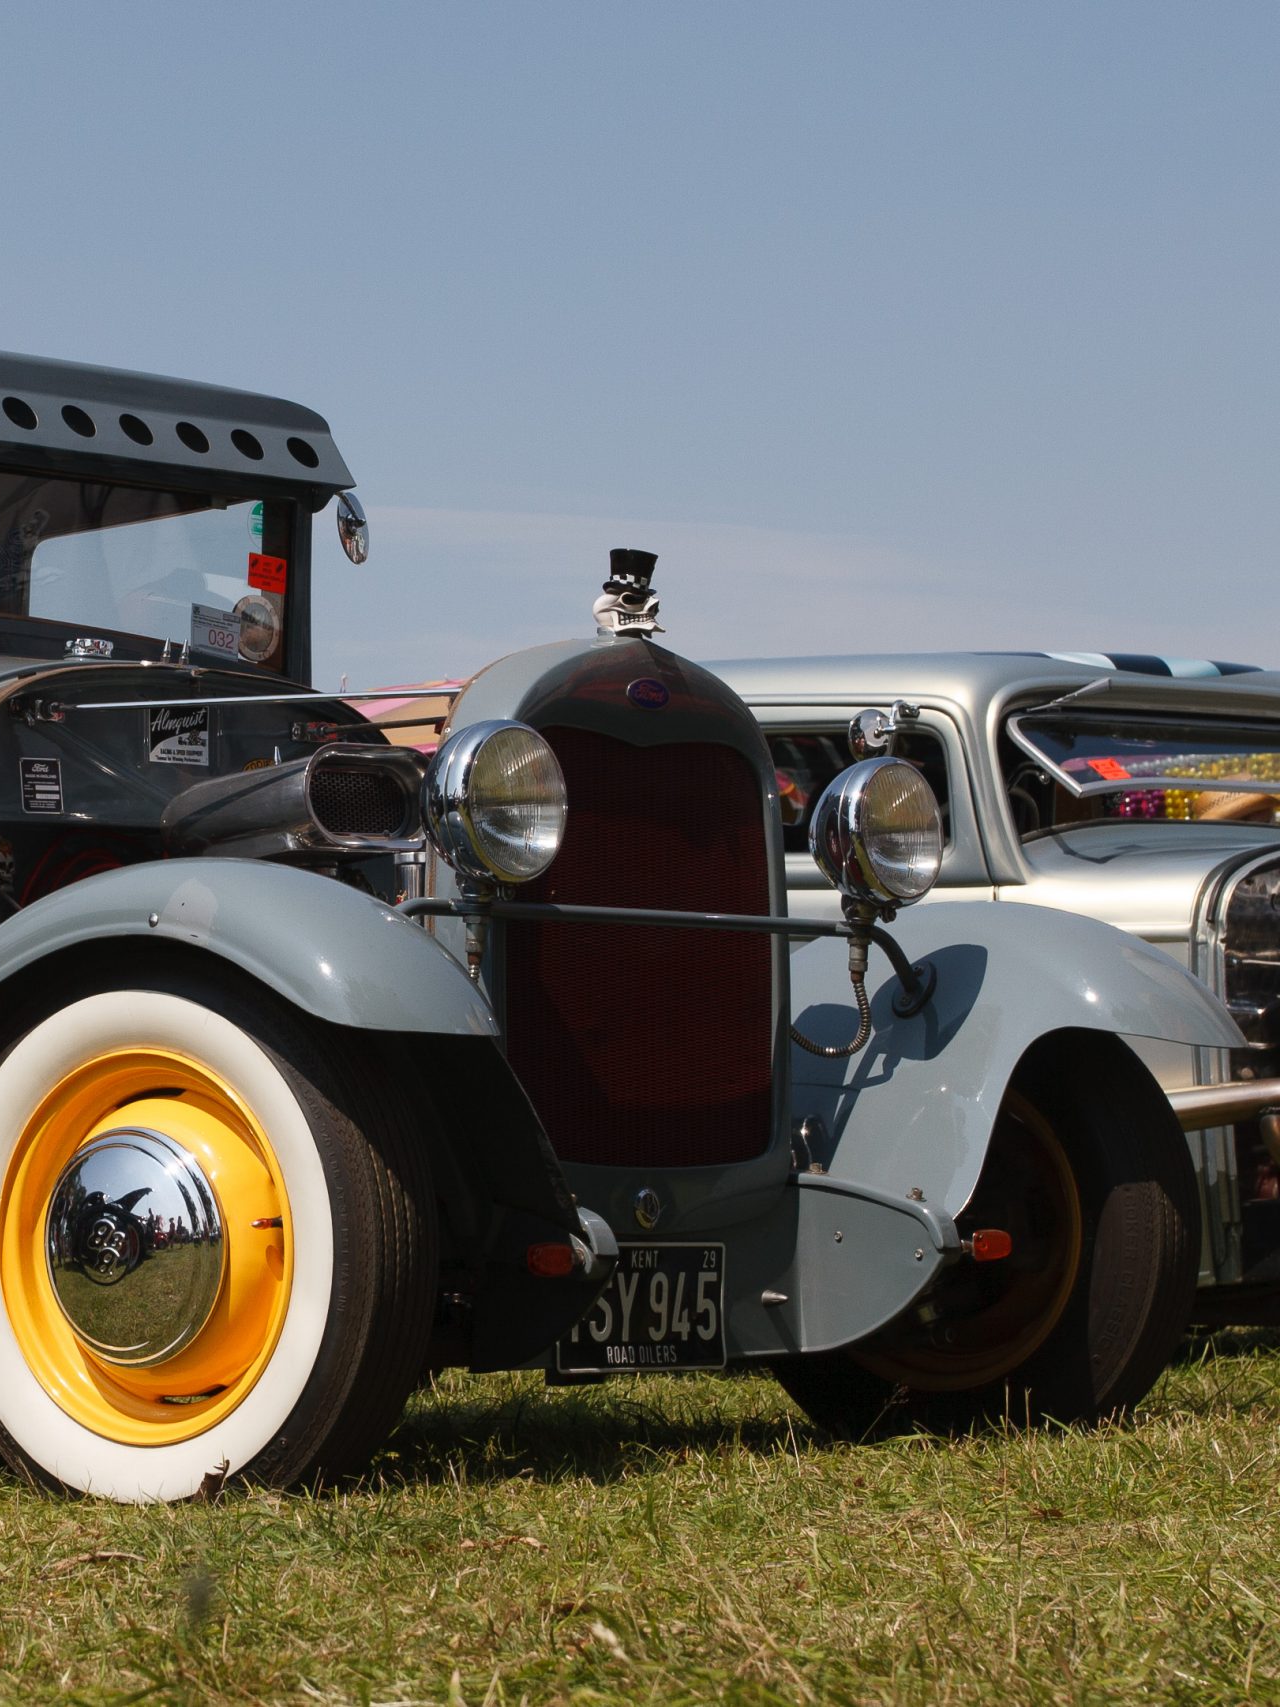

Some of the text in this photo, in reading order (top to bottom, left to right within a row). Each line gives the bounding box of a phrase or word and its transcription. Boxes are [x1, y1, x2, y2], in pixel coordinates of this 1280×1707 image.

[208, 629, 235, 650] 032
[151, 708, 207, 735] Almquist
[31, 763, 49, 773] Ford
[631, 1250, 716, 1268] KENT 29
[571, 1271, 718, 1343] SY 945
[606, 1345, 677, 1364] ROAD OILERS
